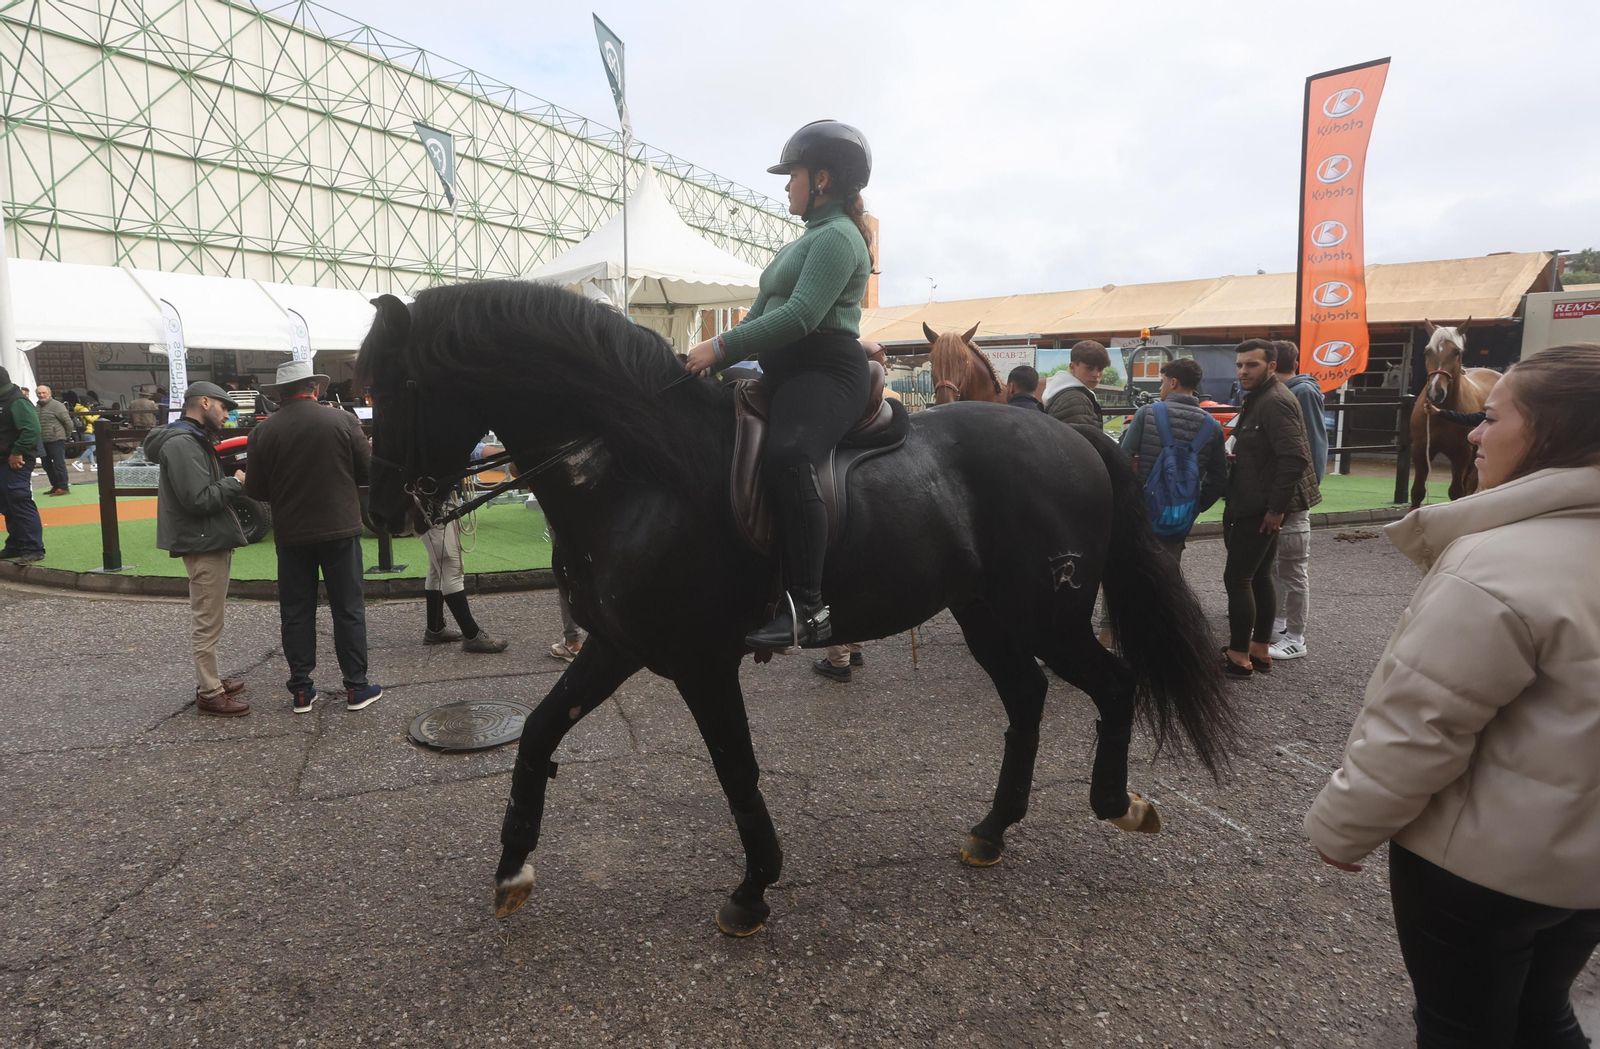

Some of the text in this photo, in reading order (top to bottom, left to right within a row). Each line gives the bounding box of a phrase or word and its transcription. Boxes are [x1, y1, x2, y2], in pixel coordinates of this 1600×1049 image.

[1317, 118, 1364, 136] Kubota
[1312, 185, 1354, 200] Kubota
[1307, 250, 1353, 263] Kubota
[1310, 310, 1359, 323] Kubota
[1309, 368, 1357, 381] Kubota
